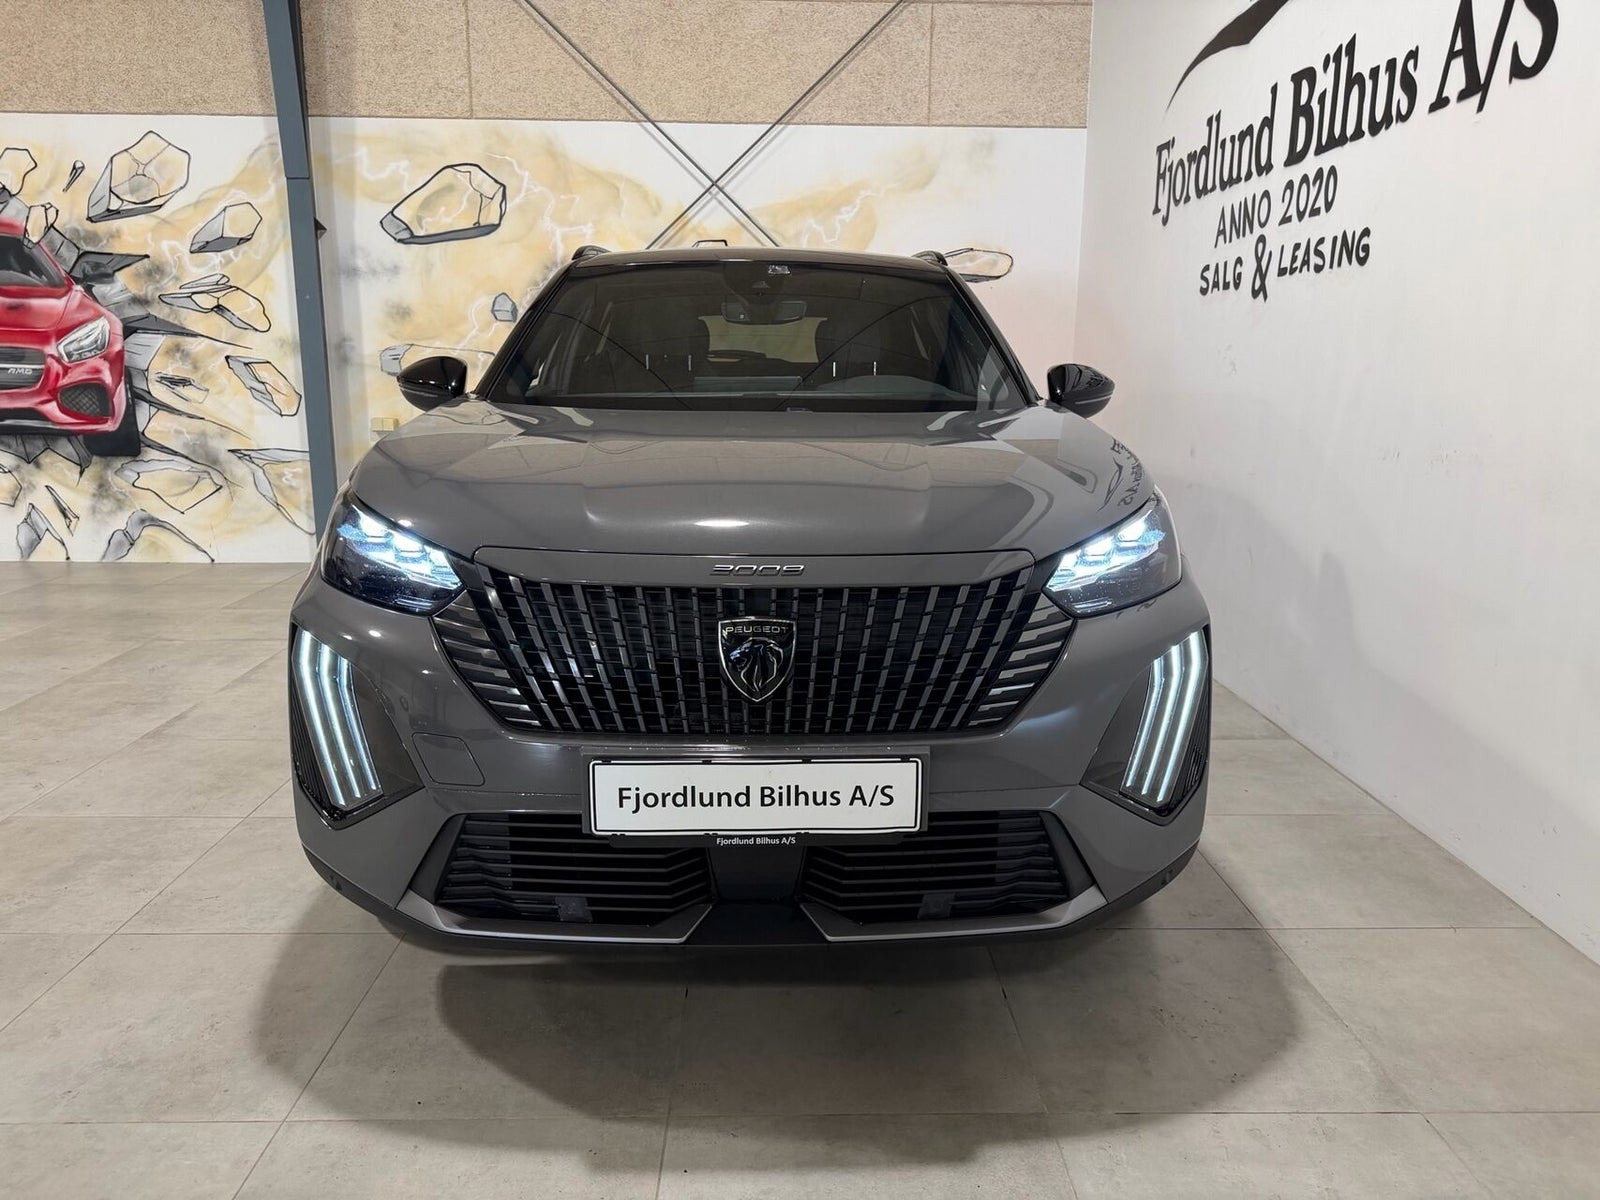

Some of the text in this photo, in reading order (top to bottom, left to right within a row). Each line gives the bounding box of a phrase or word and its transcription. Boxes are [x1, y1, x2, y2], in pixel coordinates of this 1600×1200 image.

[1152, 0, 1559, 227] Fjordlund Bilhus A/S
[1214, 165, 1338, 249] ANNO 2020
[1199, 226, 1371, 302] SALG & LEASING
[724, 625, 789, 634] PEUGEOT
[618, 784, 895, 815] Fjordlund Bilhus A/S
[716, 836, 796, 847] Fjordlund Bilhus A/S
